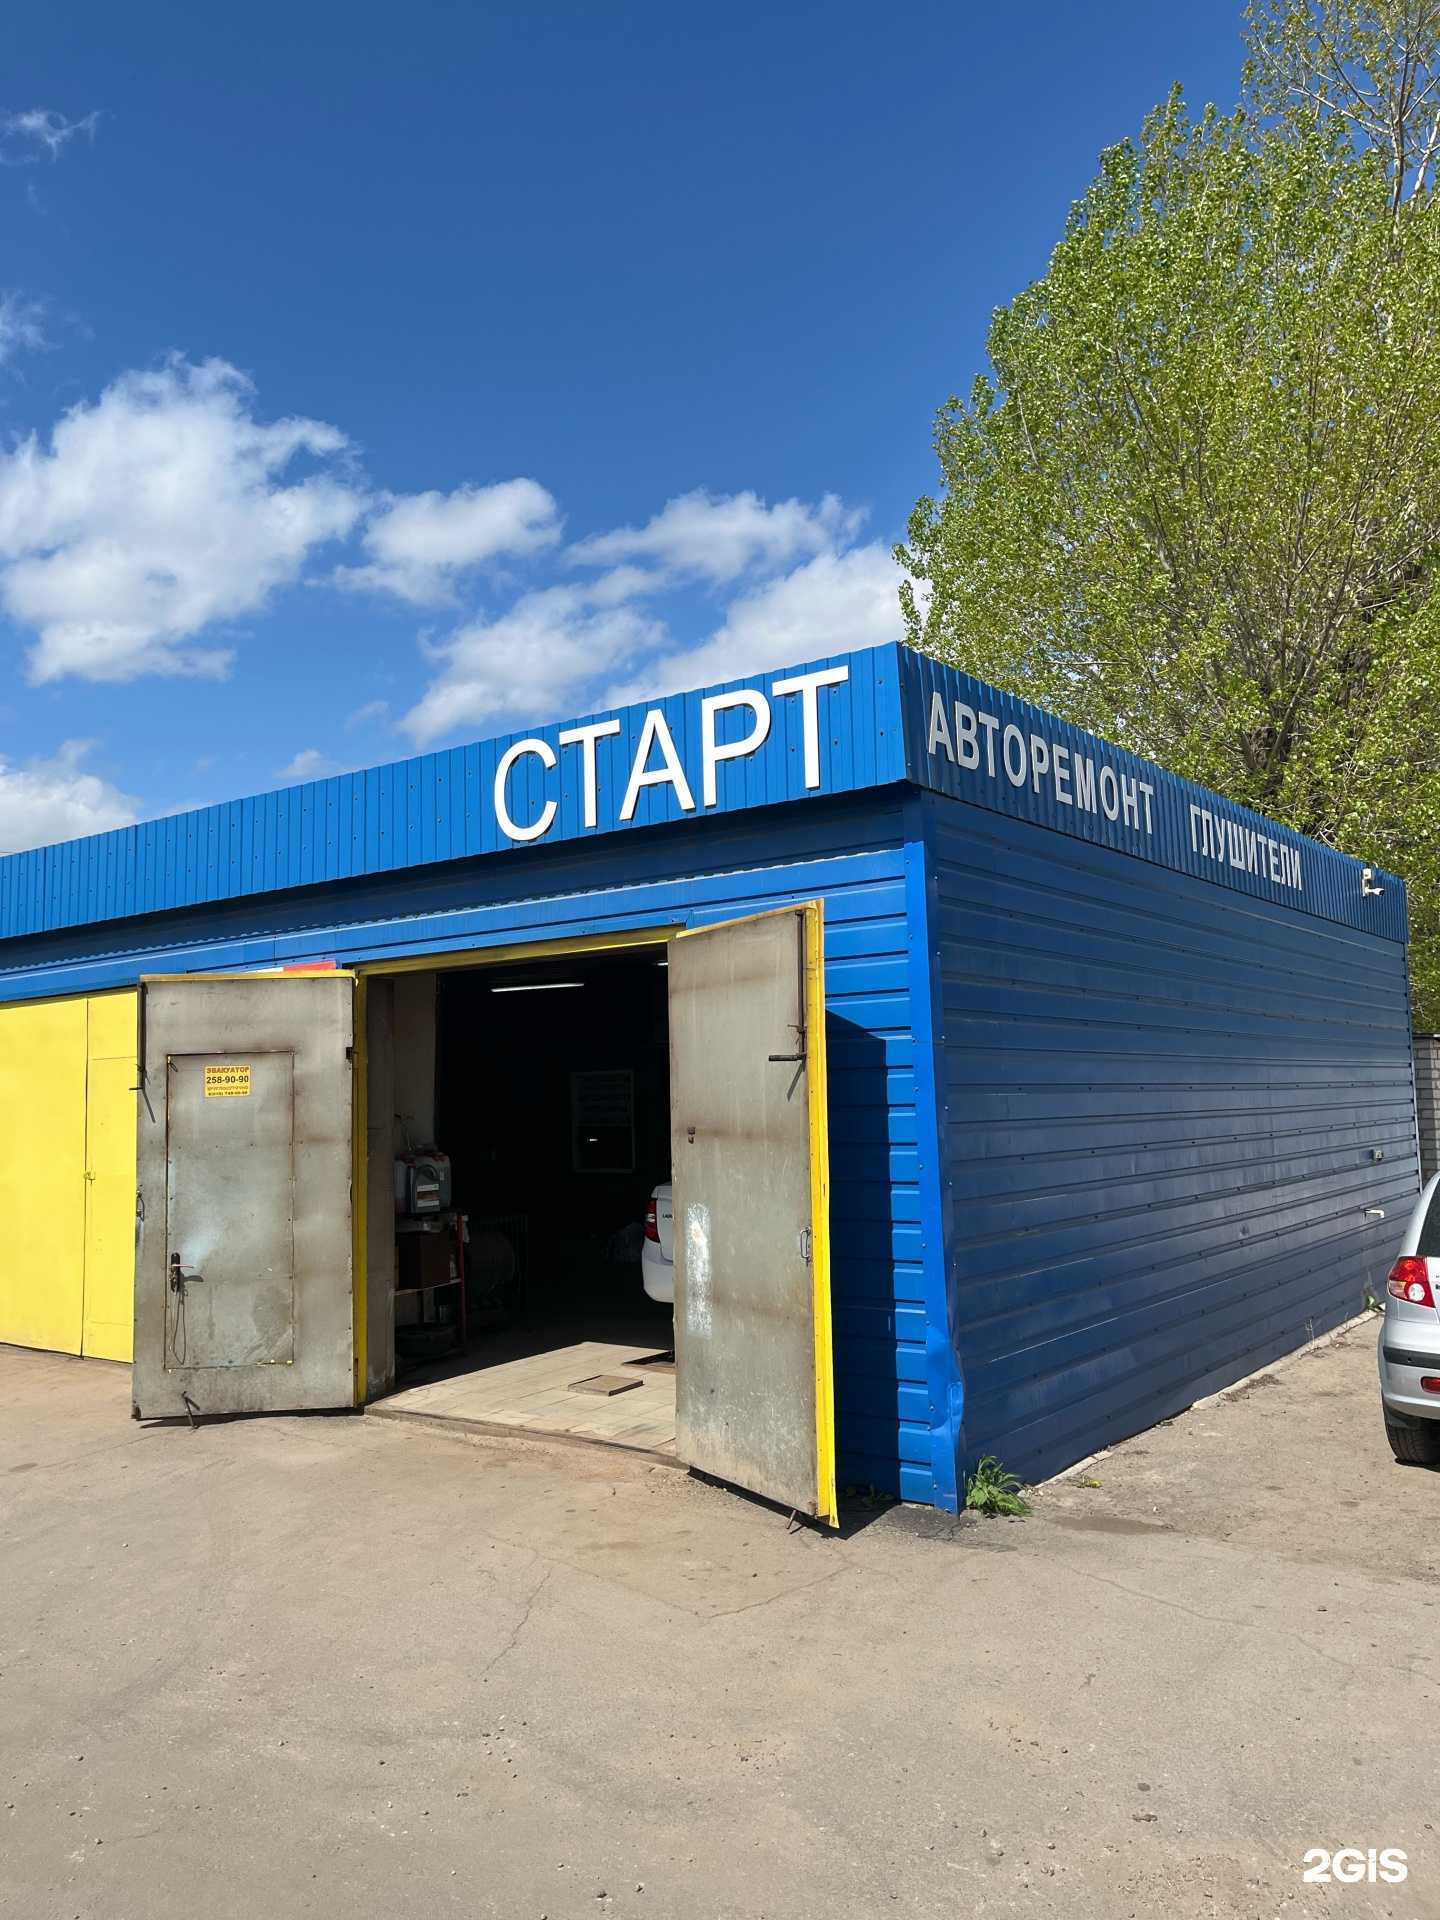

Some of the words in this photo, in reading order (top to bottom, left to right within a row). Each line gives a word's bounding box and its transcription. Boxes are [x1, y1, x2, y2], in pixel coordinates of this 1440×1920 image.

[494, 665, 849, 841] СТАРТ
[928, 691, 1154, 835] АВТОРЕМОНТ
[1189, 803, 1303, 891] ГЛУШИТЕЛИ
[206, 1075, 249, 1084] 258-90-90
